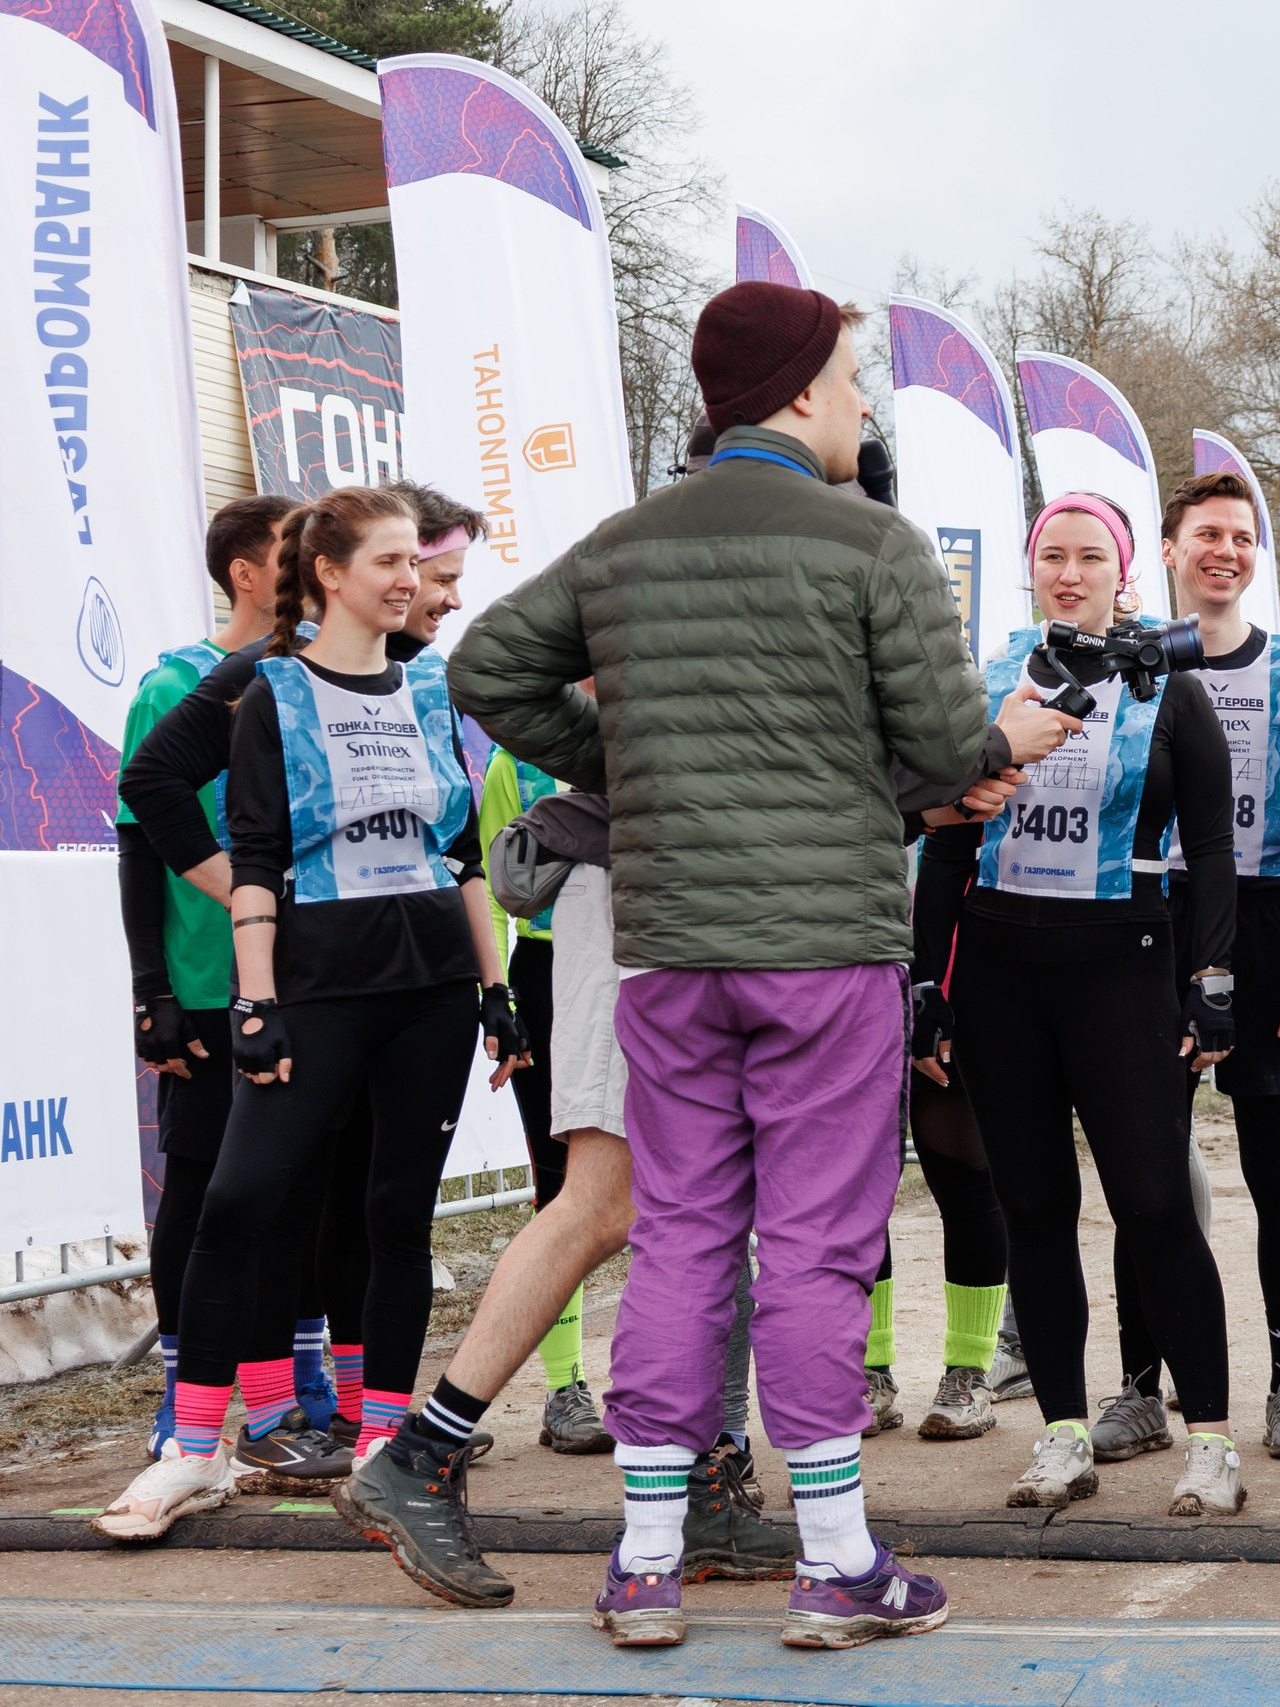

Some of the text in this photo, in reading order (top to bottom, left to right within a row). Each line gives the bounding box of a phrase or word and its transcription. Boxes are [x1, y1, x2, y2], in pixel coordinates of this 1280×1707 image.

[279, 386, 405, 488] ГОН
[1076, 633, 1106, 648] RONIN
[1217, 697, 1264, 708] ГЕРОЕВ
[327, 721, 418, 734] ГОНКА ГЕРОЕВ
[346, 741, 411, 758] Sminex
[1012, 803, 1089, 844] 5403
[374, 864, 418, 875] ГАЗПРОМБАНК
[1024, 866, 1076, 877] ГАЗПРОМБАНК
[233, 1003, 253, 1014] SPORT
[237, 998, 253, 1007] GURU
